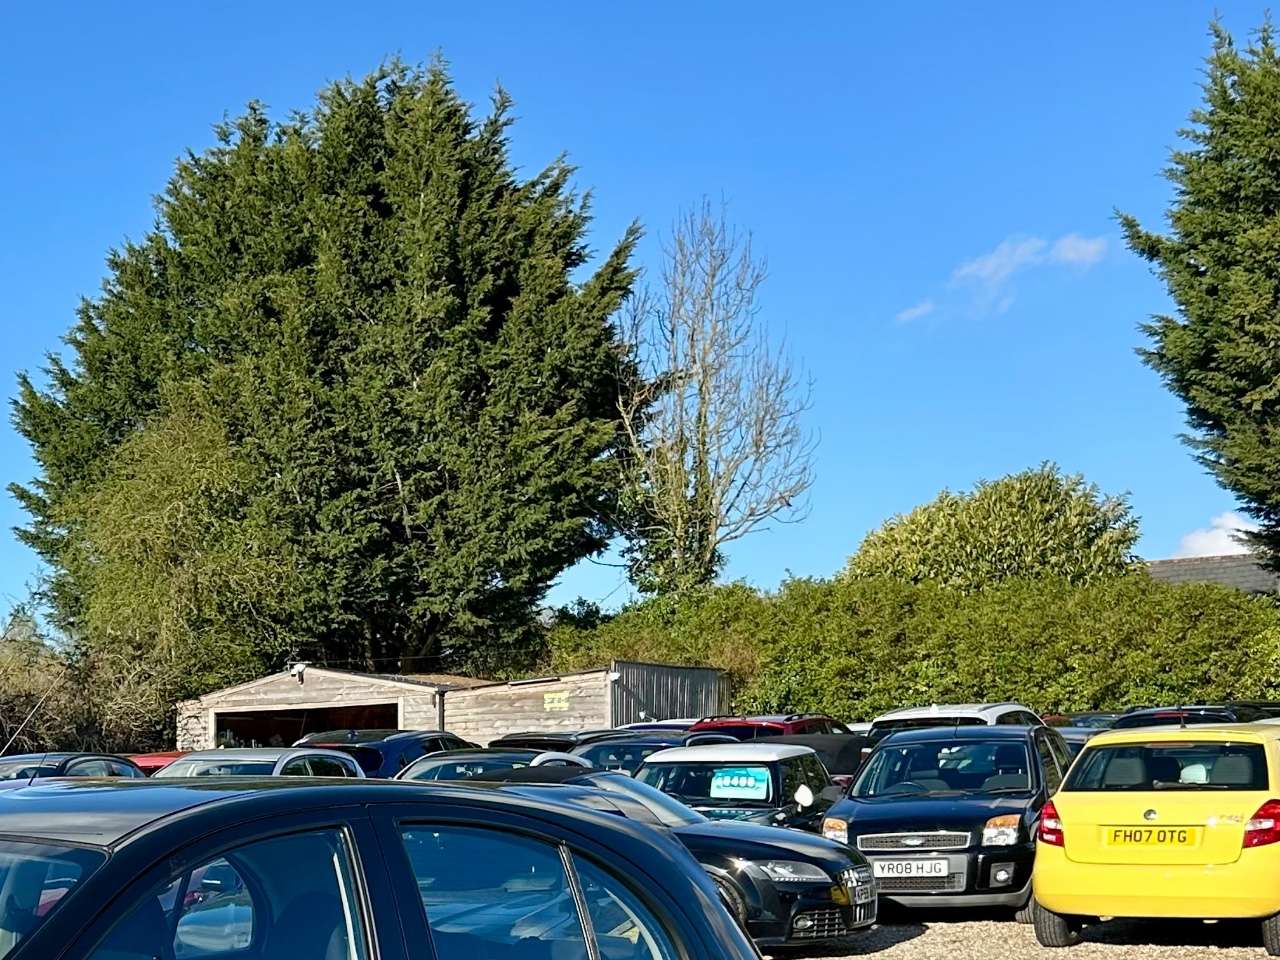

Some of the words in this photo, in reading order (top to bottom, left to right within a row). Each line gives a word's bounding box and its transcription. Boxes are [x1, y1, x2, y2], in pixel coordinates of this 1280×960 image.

[1113, 829, 1153, 843] FH07
[1157, 829, 1187, 843] OTG
[879, 862, 912, 874] YR08
[916, 862, 942, 874] HJG
